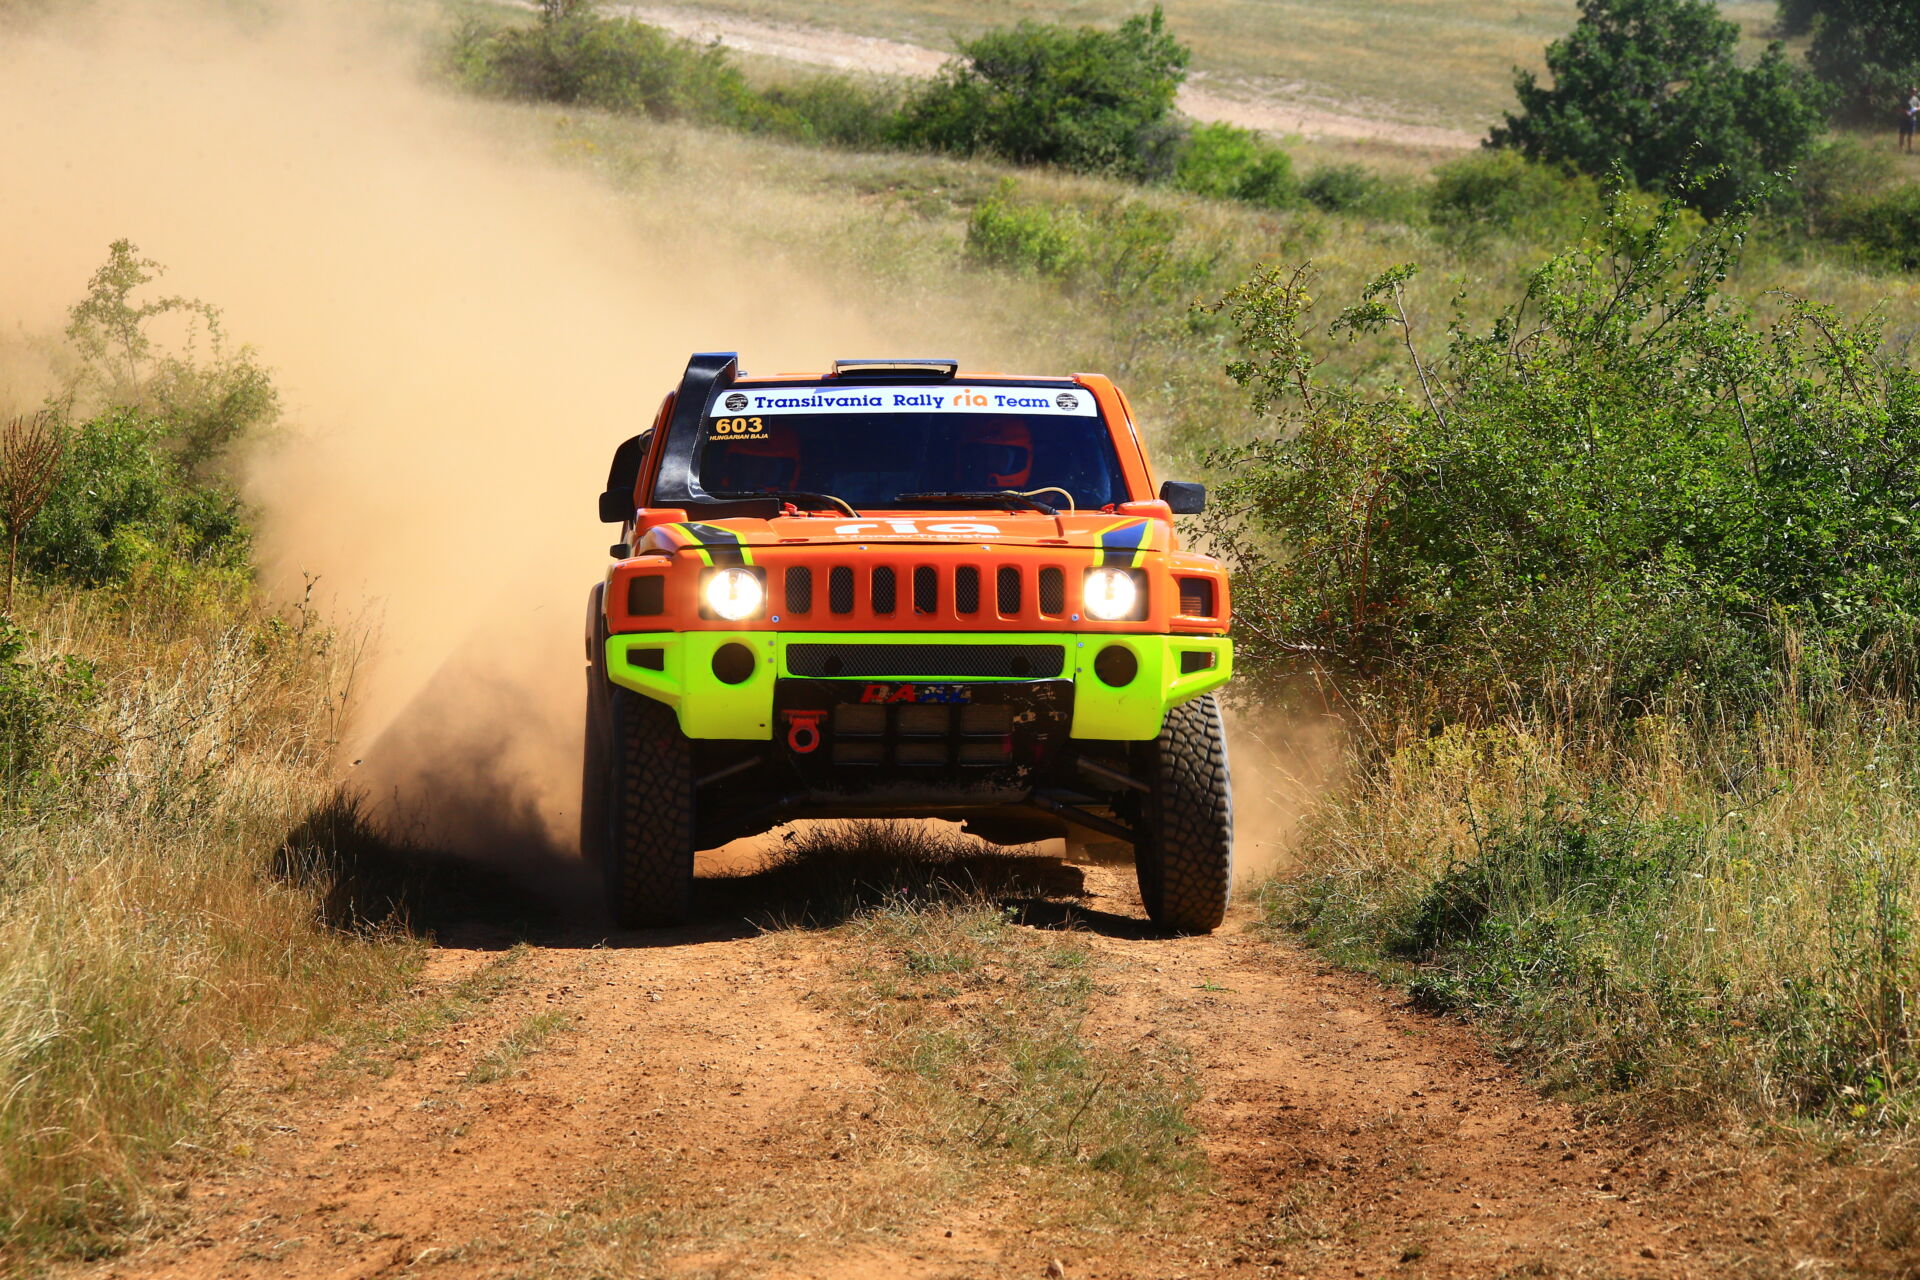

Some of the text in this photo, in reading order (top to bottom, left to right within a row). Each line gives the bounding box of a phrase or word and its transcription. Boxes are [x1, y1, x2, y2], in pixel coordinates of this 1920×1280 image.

[754, 394, 882, 408] Transilvania
[893, 394, 945, 409] Rally
[953, 388, 988, 406] ria
[994, 395, 1051, 408] Team
[715, 417, 763, 434] 603
[709, 432, 769, 441] HUNGARIAN BAJA
[834, 520, 1001, 534] ria
